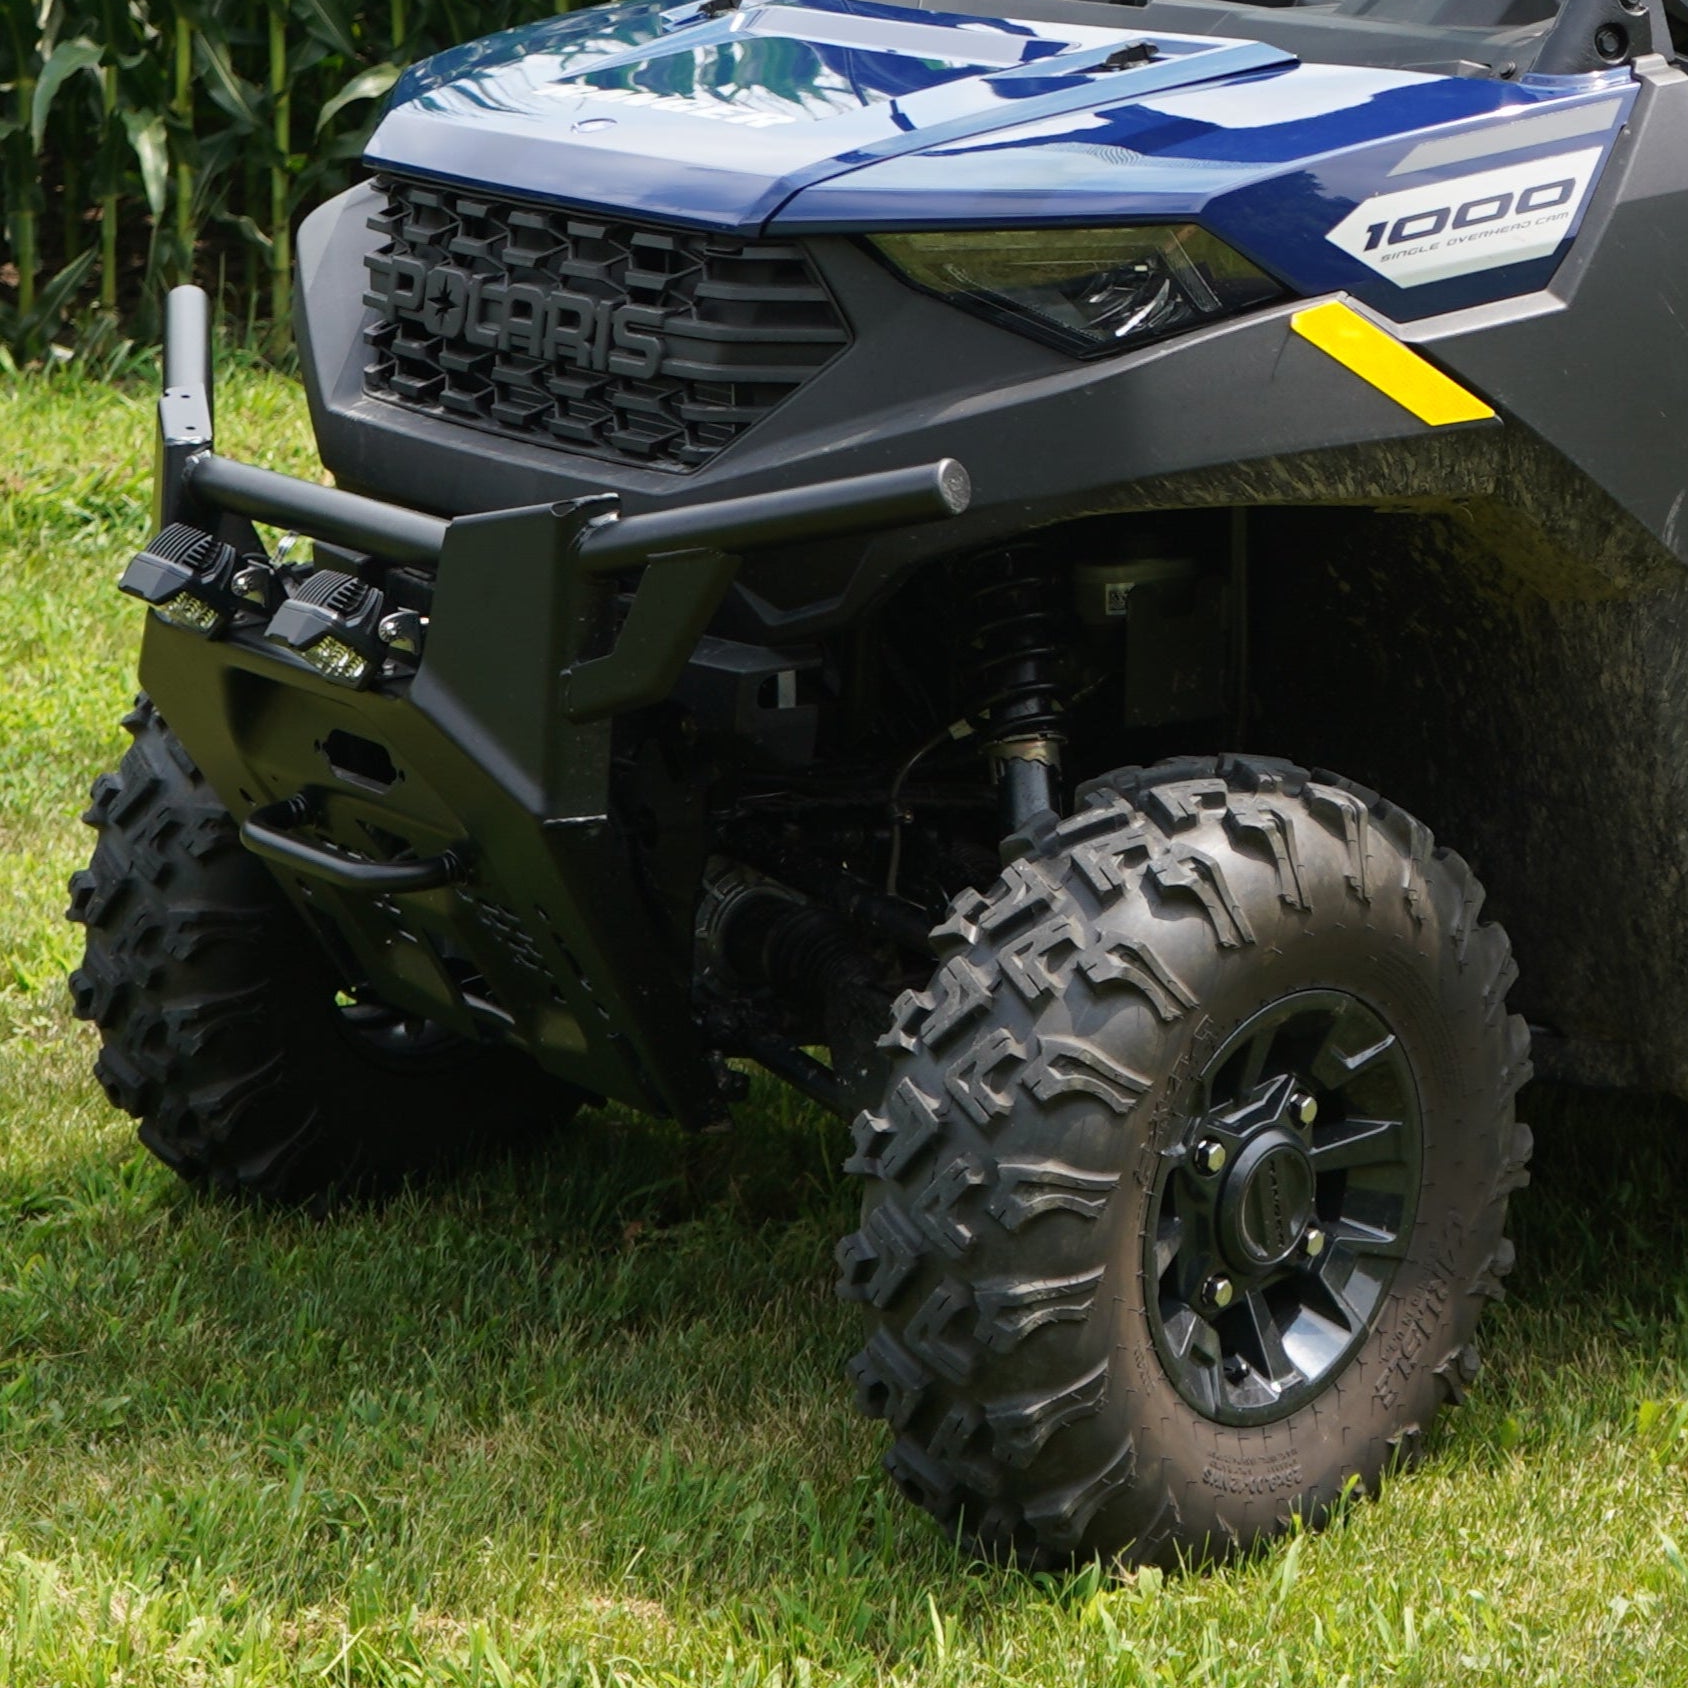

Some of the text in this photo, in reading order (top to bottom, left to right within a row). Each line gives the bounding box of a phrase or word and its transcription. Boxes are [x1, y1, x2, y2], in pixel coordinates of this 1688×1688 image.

[1363, 177, 1576, 252] 1000
[1380, 211, 1570, 263] SINGLE OVERHEAD CAM
[388, 255, 662, 379] POLARIS
